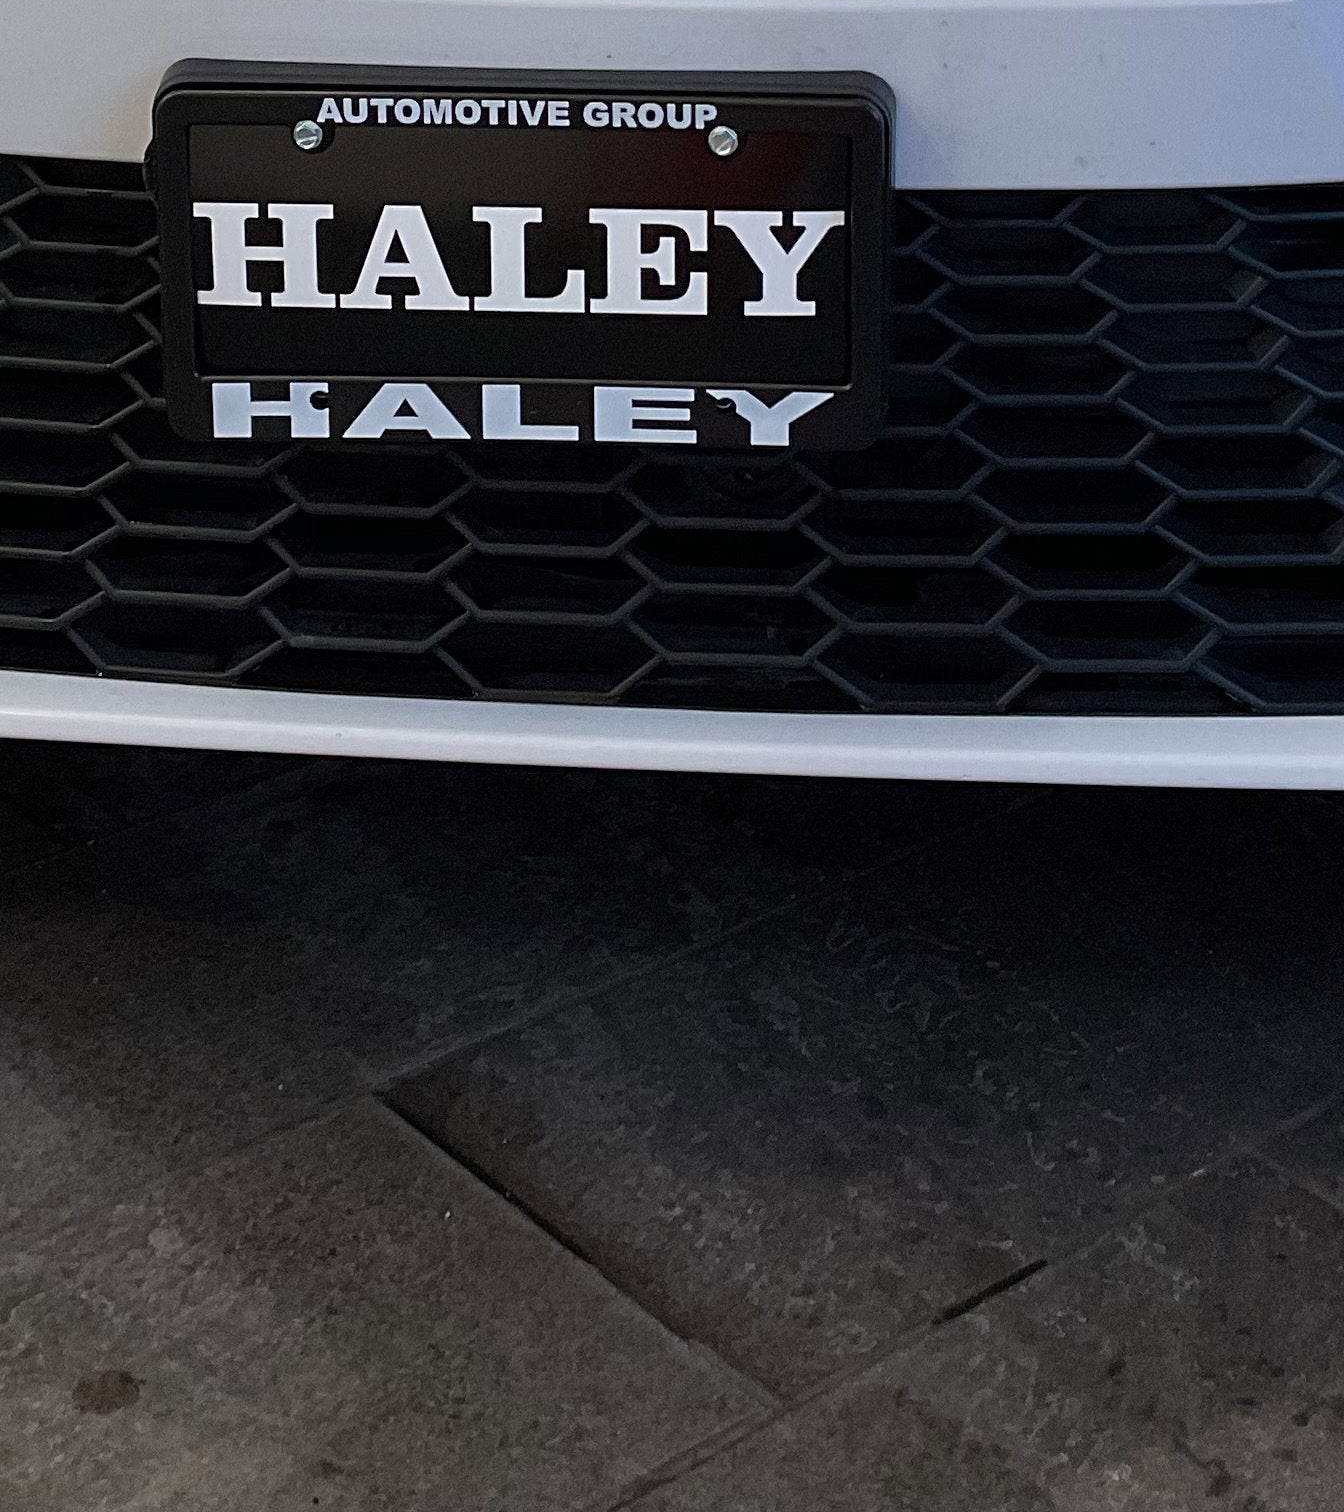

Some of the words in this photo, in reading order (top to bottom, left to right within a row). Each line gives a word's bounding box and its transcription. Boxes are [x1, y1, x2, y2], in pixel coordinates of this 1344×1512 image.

[316, 97, 571, 127] AUTOMOTIVE
[582, 101, 718, 130] GROUP
[192, 202, 846, 317] HALEY
[211, 381, 835, 447] HALEY
